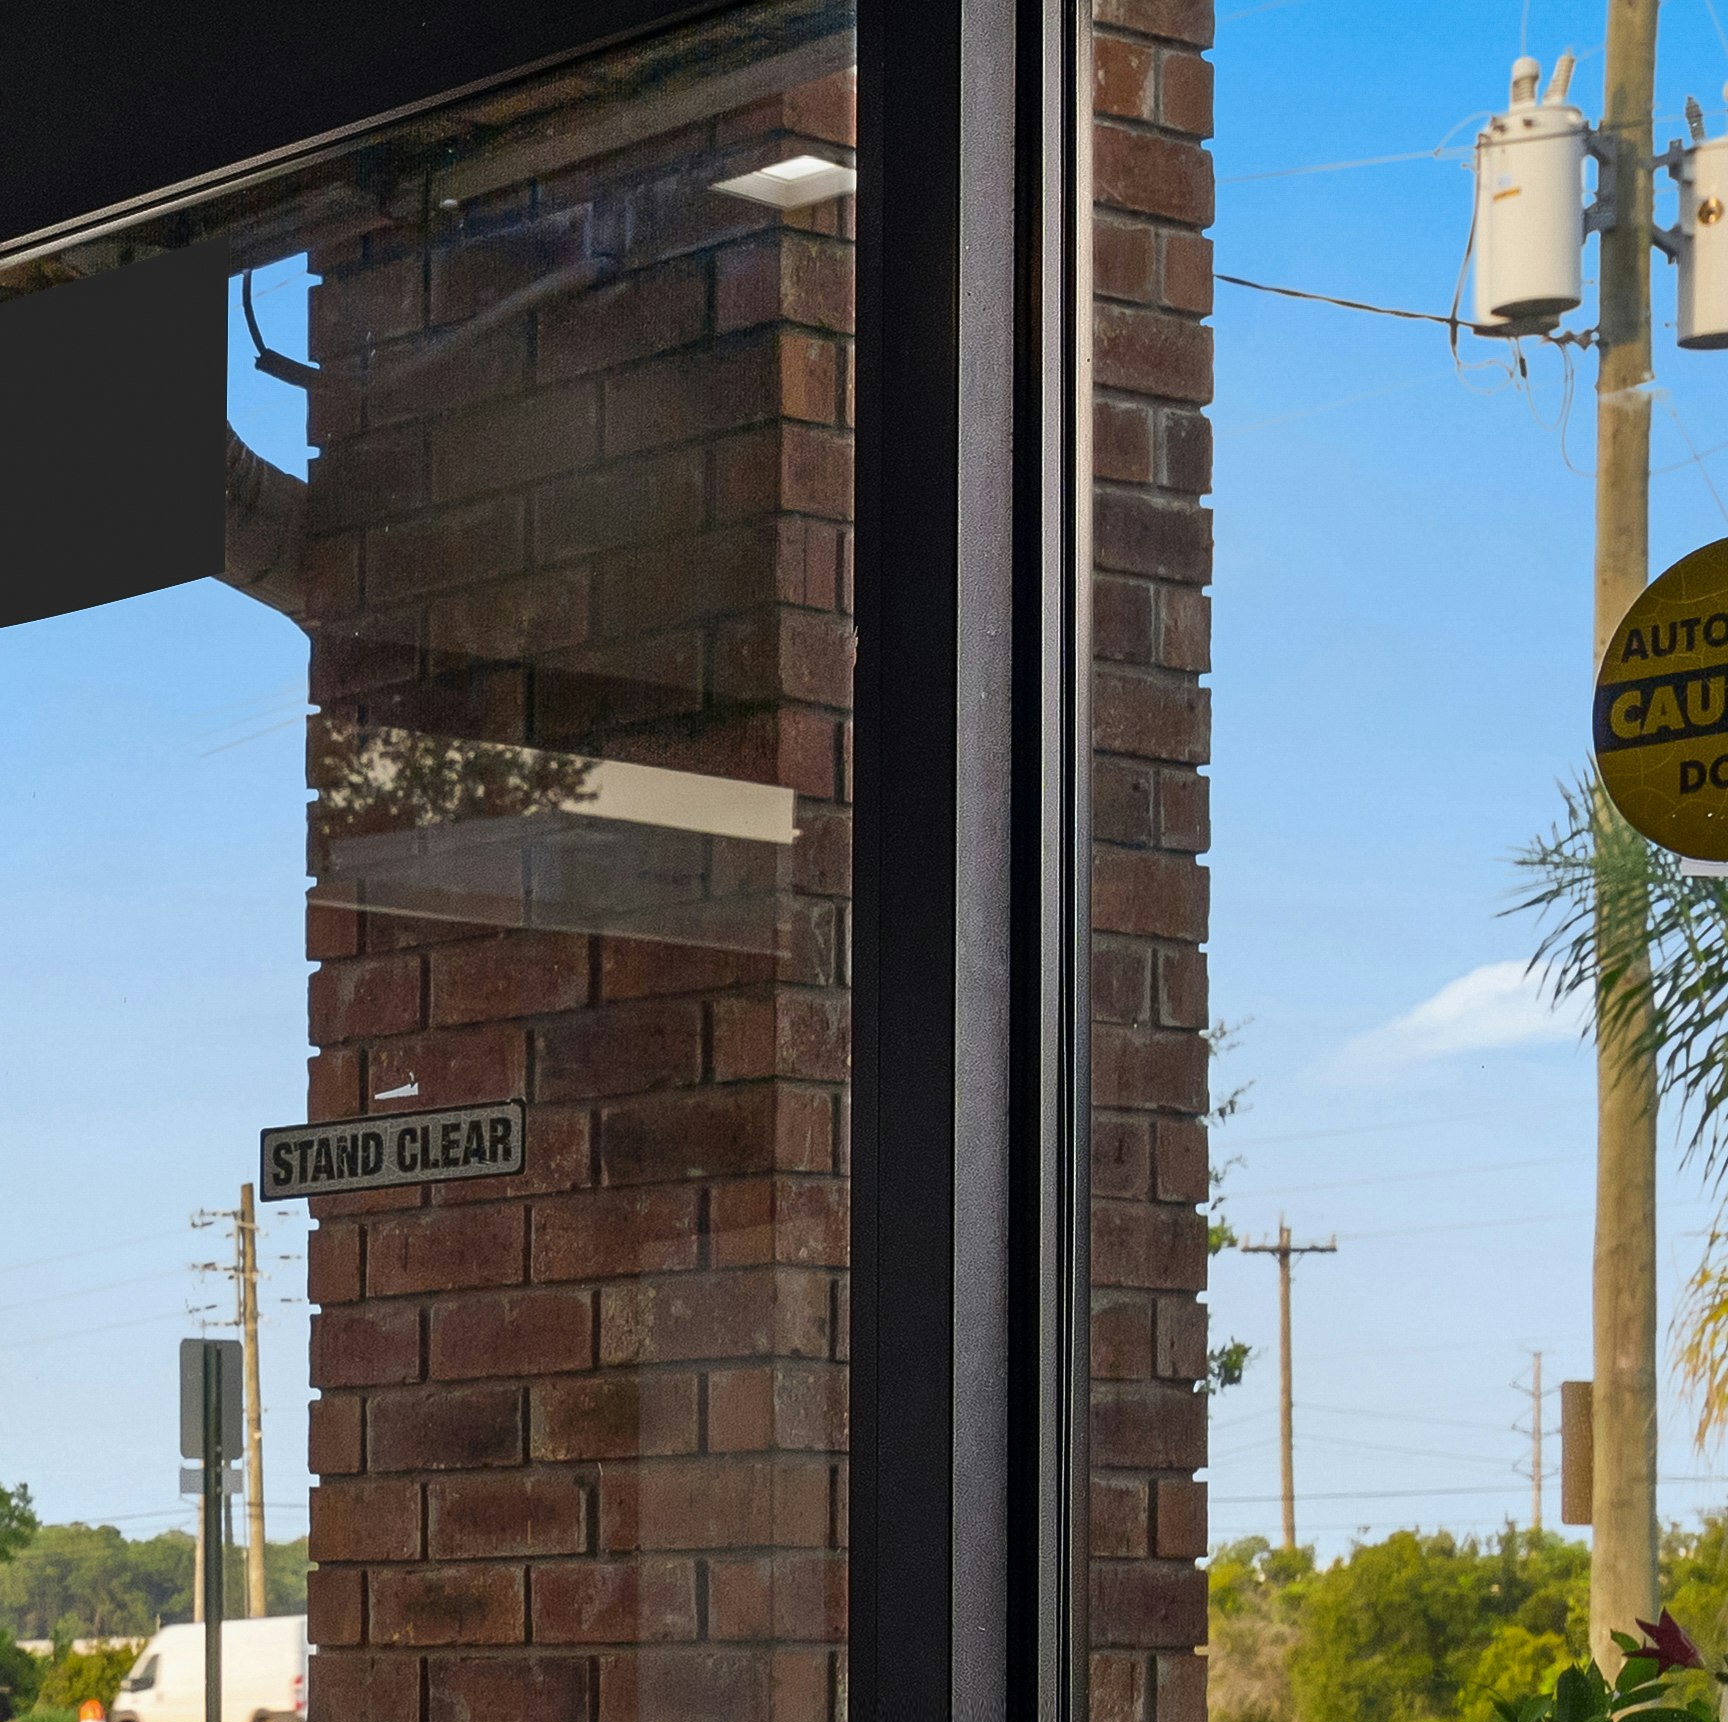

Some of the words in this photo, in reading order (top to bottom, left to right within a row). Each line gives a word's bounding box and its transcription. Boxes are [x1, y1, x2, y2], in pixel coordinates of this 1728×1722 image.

[1621, 612, 1728, 664] AUTO
[1610, 674, 1726, 739] CAU
[272, 1131, 385, 1188] STAND
[397, 1116, 513, 1173] CLEAR
